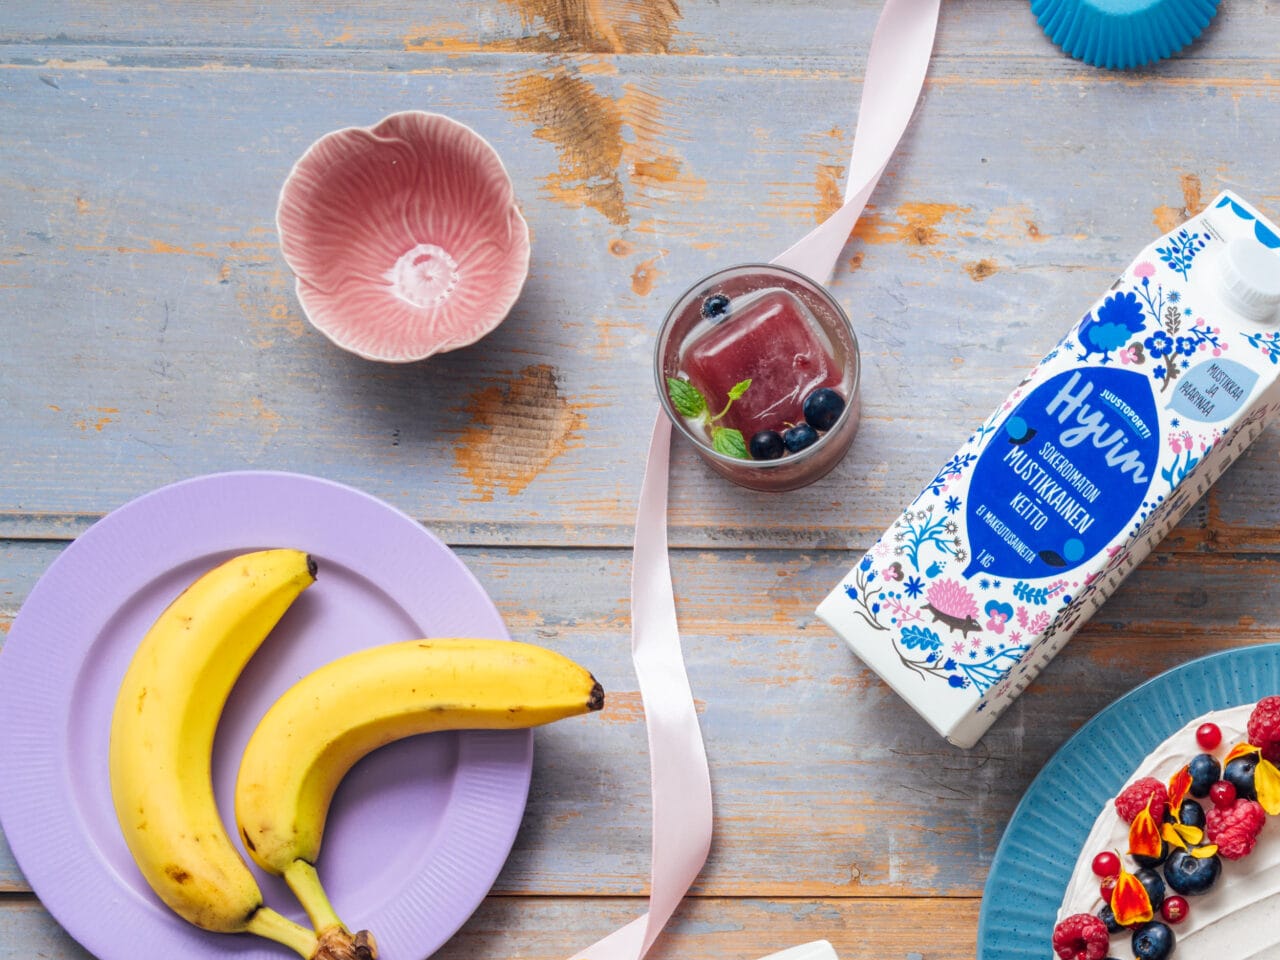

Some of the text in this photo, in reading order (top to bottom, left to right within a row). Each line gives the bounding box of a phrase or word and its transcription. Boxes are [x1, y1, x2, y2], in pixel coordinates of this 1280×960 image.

[1205, 384, 1219, 399] JA
[1207, 363, 1244, 401] MUSTIKKAA
[1045, 371, 1148, 484] Hyvin
[1100, 389, 1152, 439] JUUSTOPORTTI
[1003, 445, 1095, 534] MUSTIKKAINEN
[1039, 442, 1101, 503] SOKEROIMATON
[976, 504, 1036, 564] EI MAKEUTUSAINEITA
[1009, 491, 1049, 531] KEITTO
[980, 553, 995, 568] KG
